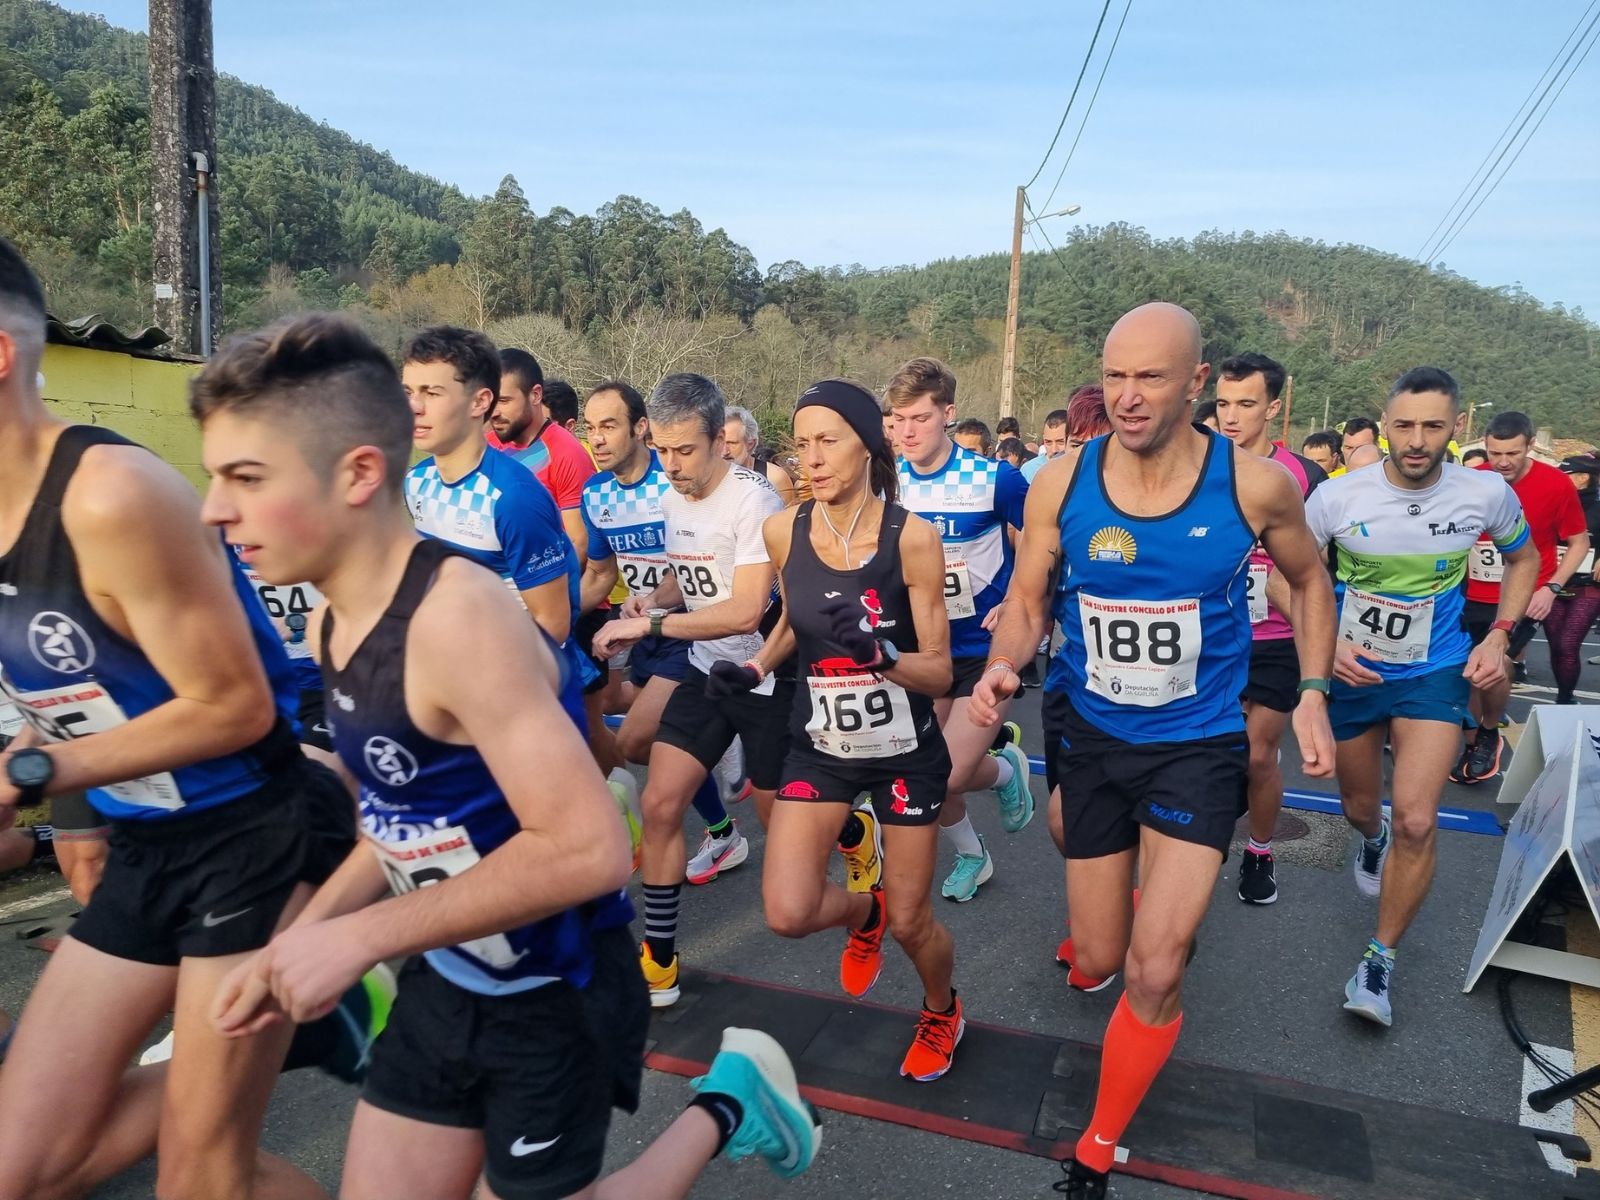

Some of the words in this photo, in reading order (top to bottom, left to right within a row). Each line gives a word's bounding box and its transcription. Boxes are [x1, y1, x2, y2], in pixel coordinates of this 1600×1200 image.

[258, 585, 314, 618] 64
[1094, 602, 1127, 613] SILVESTRE
[1129, 606, 1165, 615] CONCELLO
[1167, 605, 1176, 614] DE
[1178, 602, 1198, 613] NEDA
[1359, 606, 1412, 640] 40
[1089, 616, 1181, 665] 188
[847, 679, 877, 687] CONCELLO
[819, 689, 894, 732] 169
[902, 807, 923, 816] Pacio
